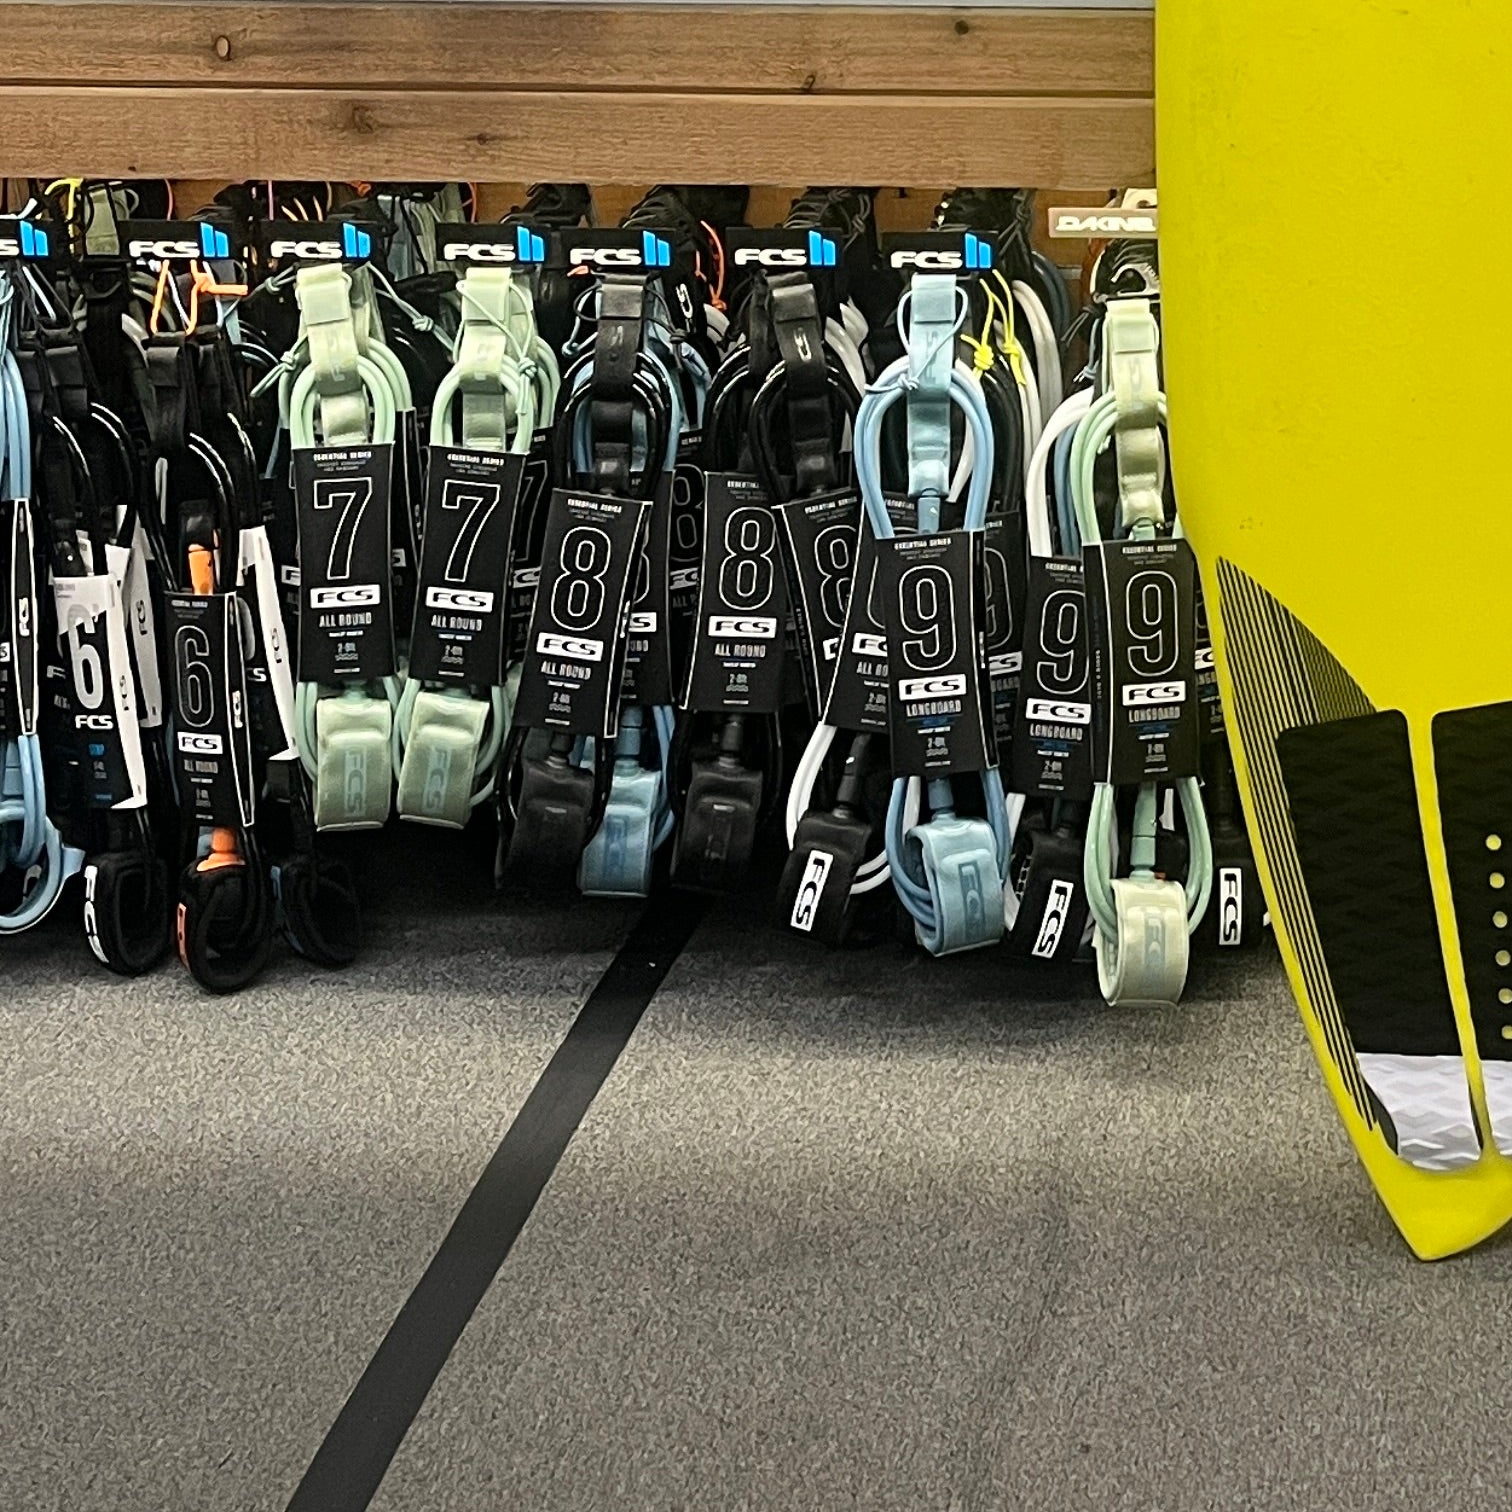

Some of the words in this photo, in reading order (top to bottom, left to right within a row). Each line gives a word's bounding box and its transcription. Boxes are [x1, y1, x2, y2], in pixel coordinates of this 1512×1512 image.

[129, 240, 200, 259] FCS
[270, 240, 343, 259] FCS
[444, 243, 516, 261] FCS
[569, 247, 642, 266] FCS
[734, 247, 807, 266] FCS
[891, 249, 963, 269] FCS
[314, 476, 372, 581] 7
[442, 479, 501, 583] 7
[719, 506, 776, 611] 8
[551, 526, 611, 632] 8
[317, 589, 374, 603] FCS
[433, 592, 487, 607] FCS
[319, 613, 337, 628] ALL
[431, 615, 447, 629] ALL
[450, 616, 483, 631] ROUND
[715, 620, 770, 634] FCS
[899, 565, 957, 672] 9
[1126, 570, 1179, 677] 9
[543, 637, 597, 656] FCS
[714, 643, 732, 657] ALL
[734, 644, 766, 658] ROUND
[1037, 590, 1091, 696] 9
[67, 604, 104, 710] 6
[175, 624, 215, 728] 6
[541, 661, 558, 677] ALL
[904, 679, 960, 696] FCS
[1129, 686, 1180, 701] FCS
[1031, 705, 1085, 719] FCS
[1128, 706, 1181, 723] LONGBOARD
[75, 714, 114, 730] FCS
[182, 736, 218, 750] FCS
[794, 853, 832, 929] FCS
[1222, 872, 1241, 943] FCS
[1035, 882, 1070, 955] FCS
